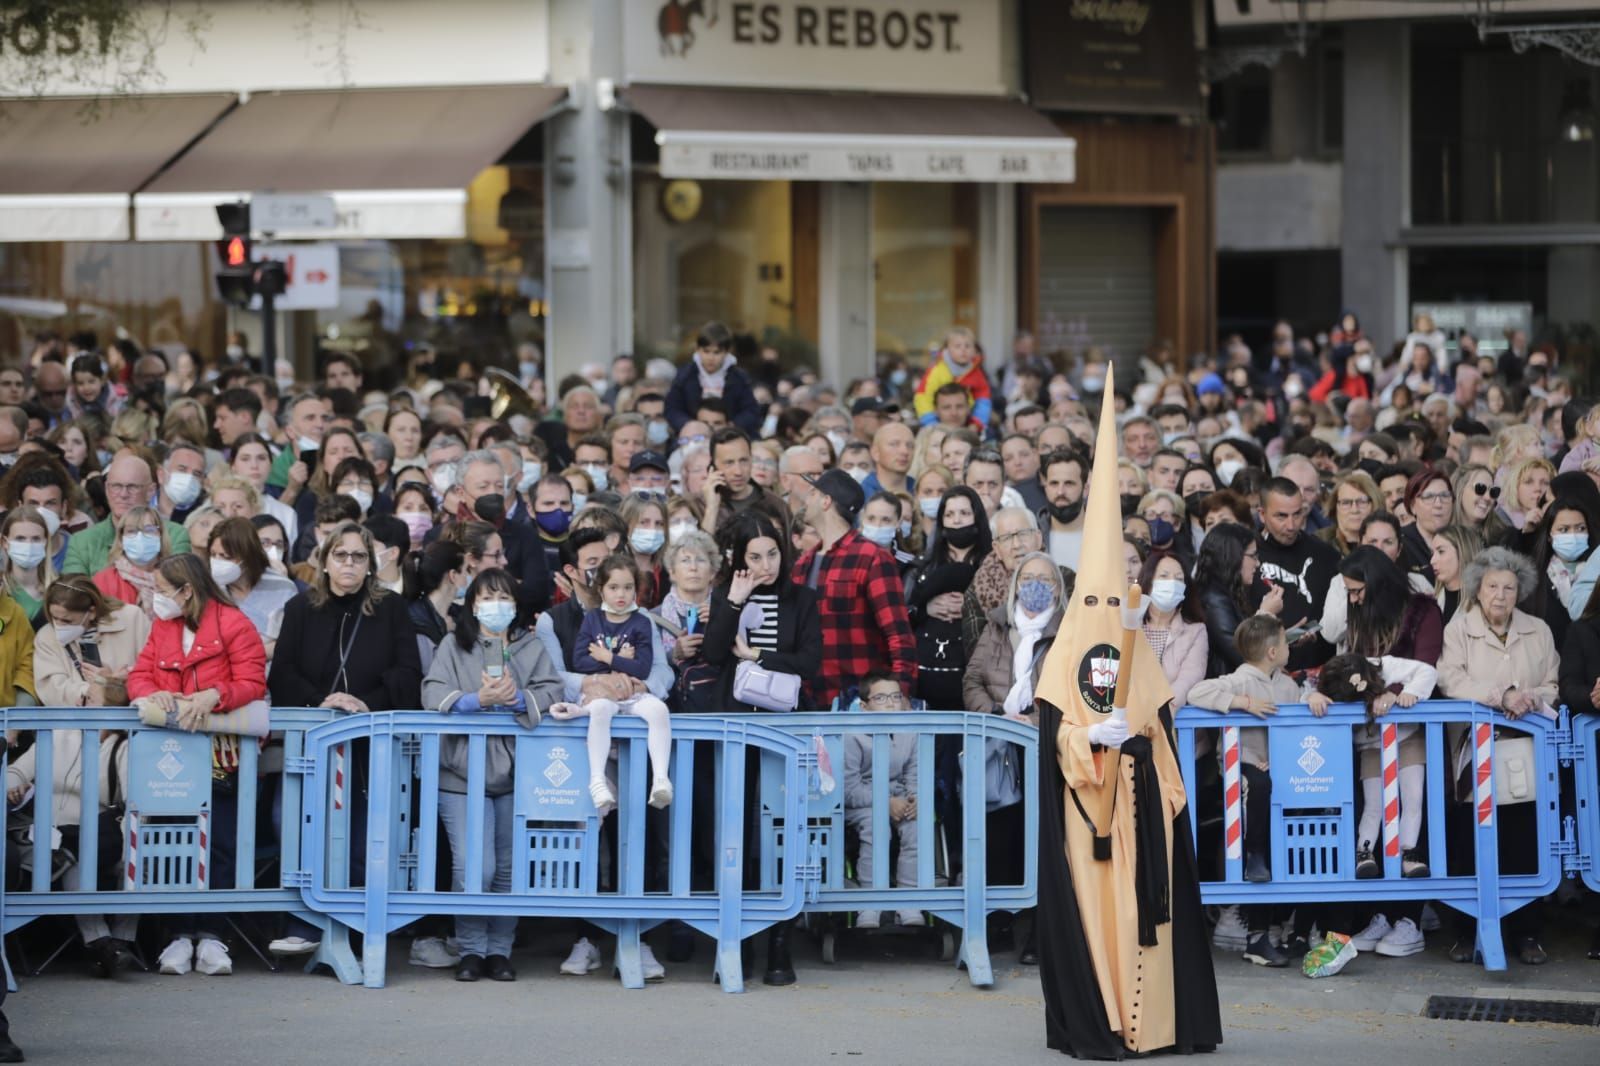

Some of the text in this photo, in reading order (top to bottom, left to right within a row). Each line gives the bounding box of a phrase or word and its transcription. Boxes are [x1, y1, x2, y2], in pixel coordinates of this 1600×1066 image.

[732, 3, 960, 52] ES REBOST
[0, 13, 116, 56] OST
[711, 151, 809, 172] RESTAURANT
[846, 153, 894, 173] TAPAS
[1000, 155, 1030, 173] BAR
[1082, 690, 1114, 714] SANTA MO
[147, 779, 193, 790] Ajuntament
[1289, 776, 1334, 786] Ajuntament
[152, 789, 188, 798] de Palma
[534, 786, 580, 797] Ajuntament
[1294, 785, 1329, 793] de Palma
[538, 796, 575, 805] de Palma
